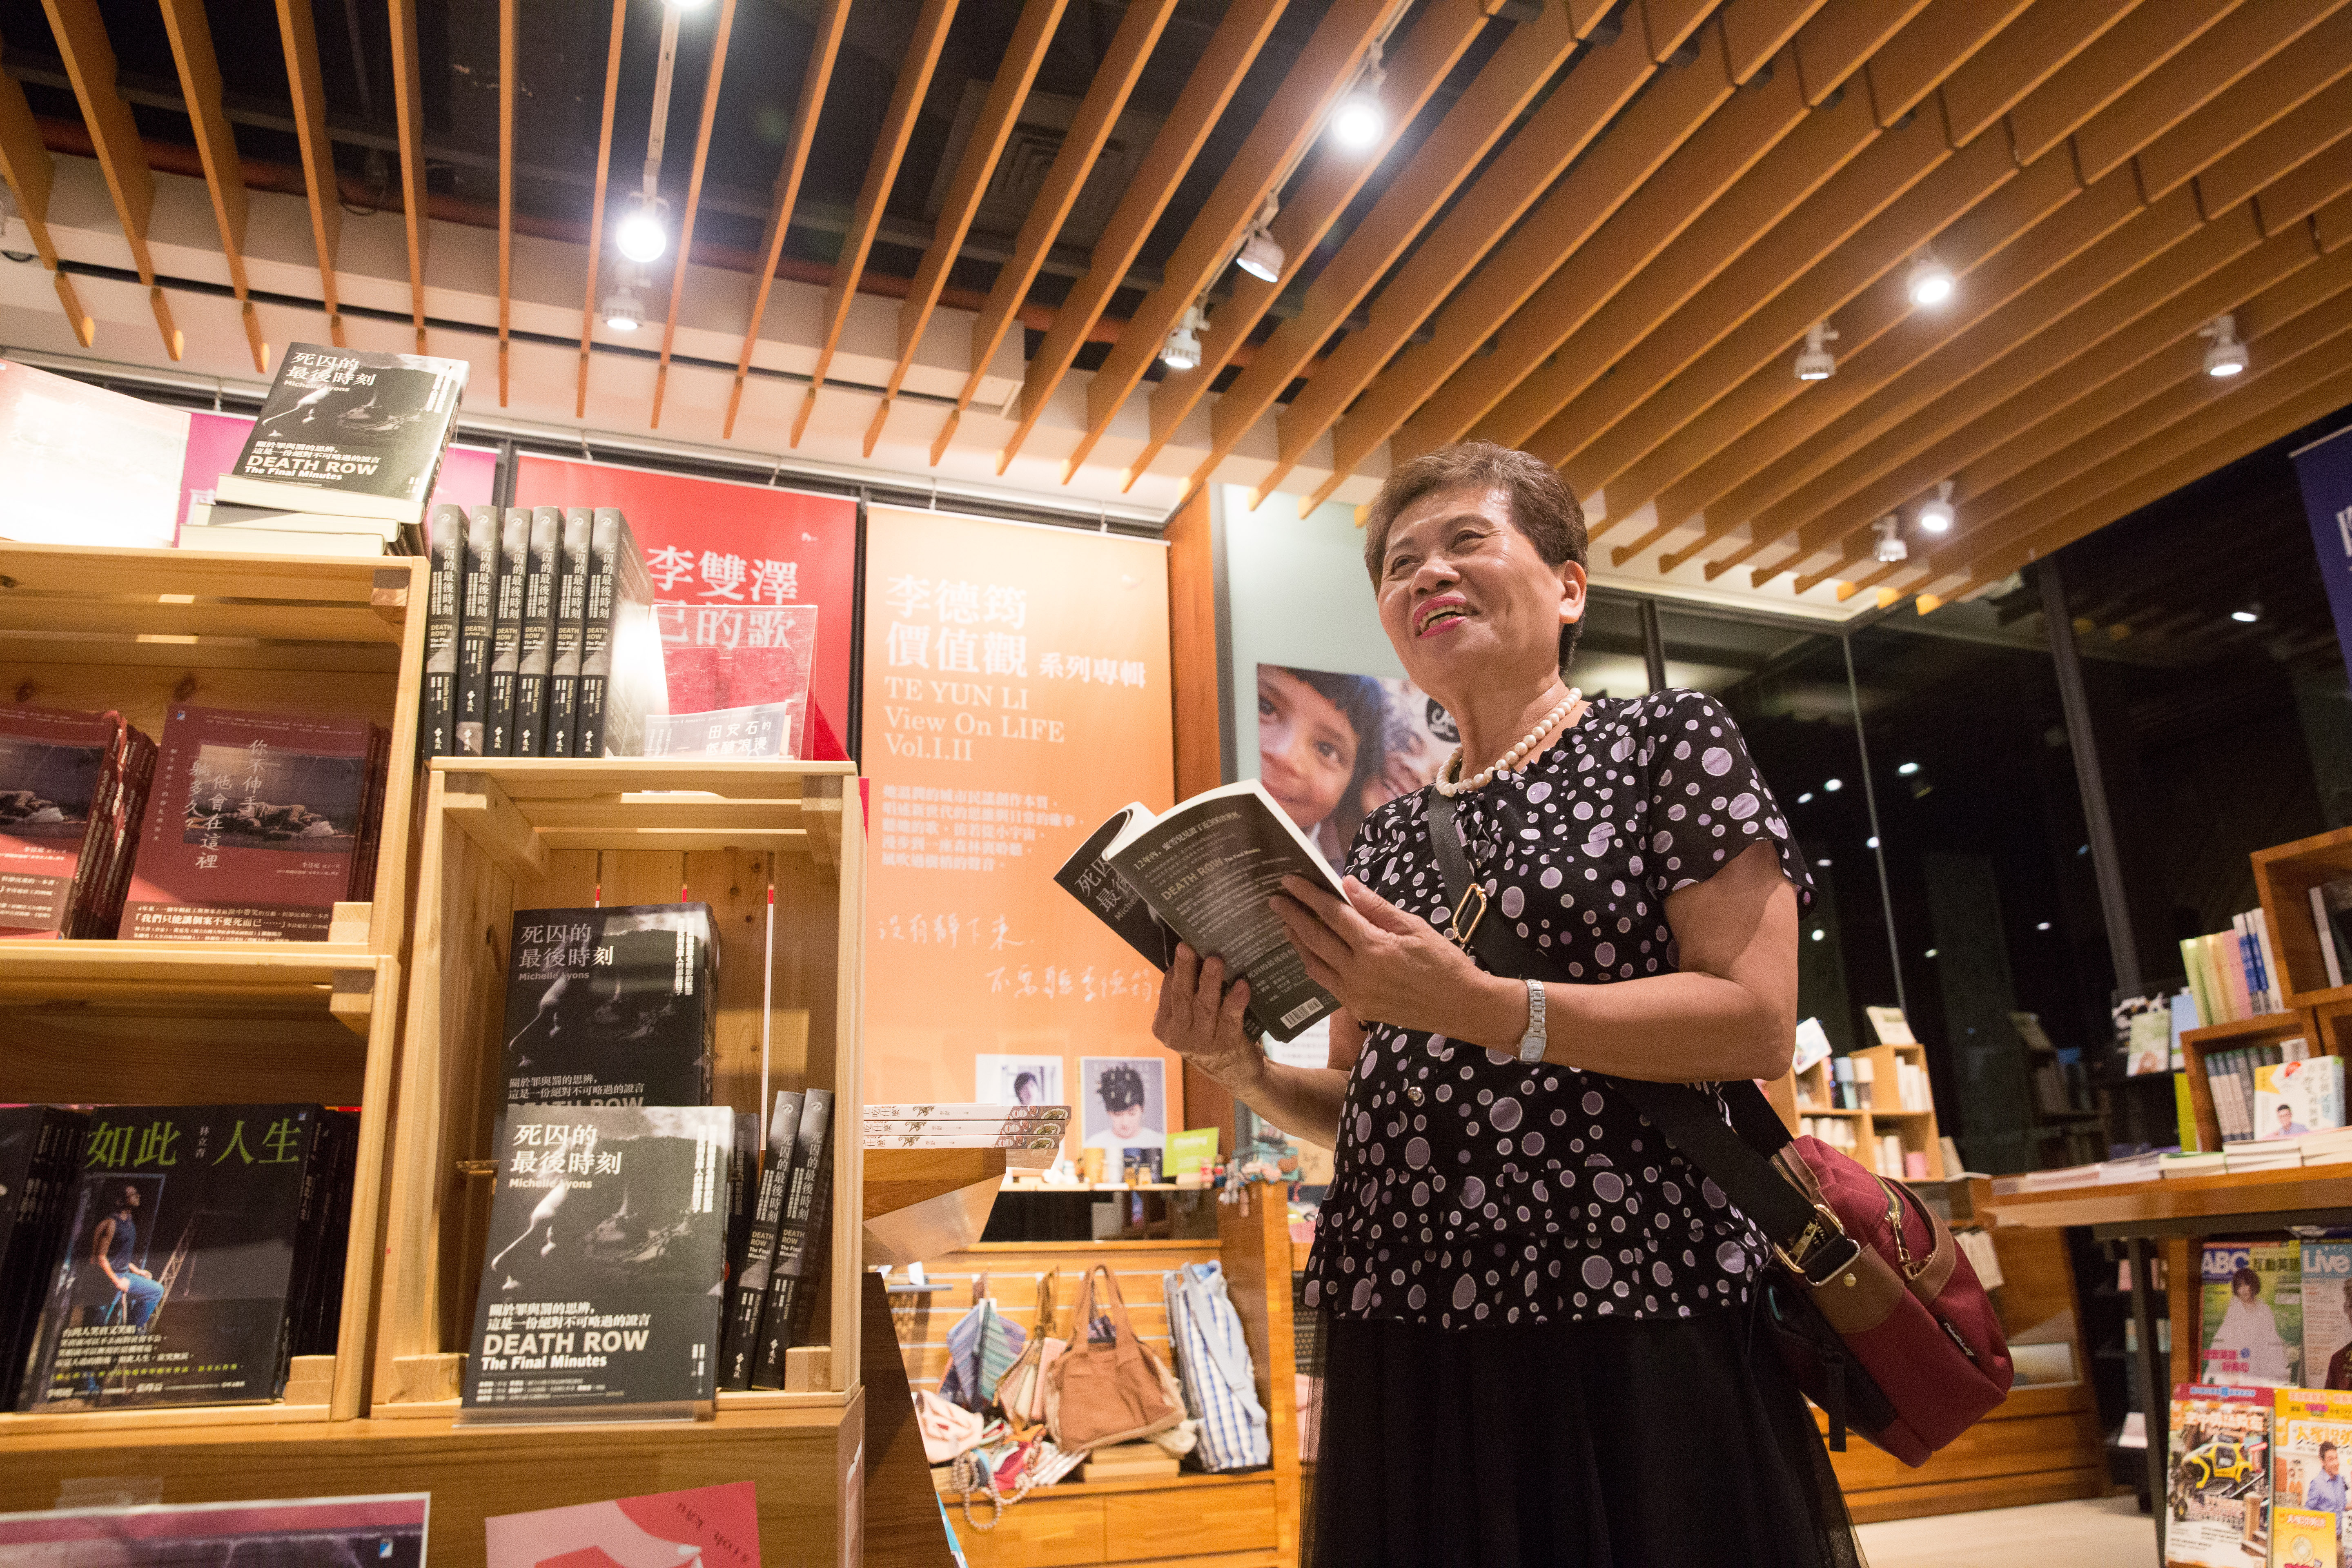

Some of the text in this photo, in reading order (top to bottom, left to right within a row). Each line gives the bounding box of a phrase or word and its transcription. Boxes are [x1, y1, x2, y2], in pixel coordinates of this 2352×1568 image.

[290, 352, 360, 372] 死囚的
[286, 366, 377, 387] 最後時刻
[245, 466, 343, 481] The Final Minutes
[247, 455, 379, 475] DEATH ROW
[442, 538, 455, 615] 死囚的最後時刻
[476, 541, 492, 617] 死囚的最後時刻
[508, 543, 526, 619] 死囚的最後時刻
[537, 541, 554, 618] 死囚的最後時刻
[570, 543, 587, 619] 死囚的最後時刻
[599, 543, 615, 619] 死囚的最後時刻
[647, 545, 798, 605] 李雙澤
[884, 574, 1027, 630] 李德筠
[884, 620, 1146, 689] 價值觀 系列專輯
[884, 676, 1029, 710] TE YUN LI
[884, 706, 1065, 743] View On LIFE
[195, 774, 232, 869] 他會在這裡
[1162, 873, 1198, 900] DEATH
[1196, 857, 1224, 876] ROW
[519, 923, 592, 945] 死囚的
[519, 945, 614, 968] 最後時刻
[519, 972, 558, 980] Michelle
[508, 1082, 645, 1099] 這是一份絕對不可略過的證言
[84, 1122, 181, 1169] 如此
[212, 1117, 302, 1167] 人生
[512, 1123, 598, 1147] 死囚的
[510, 1150, 623, 1176] 最後時刻
[766, 1133, 793, 1224] 死囚的最後時刻
[797, 1132, 822, 1221] 死囚的最後時刻
[751, 1238, 767, 1247] ROW
[752, 1231, 774, 1241] DEATH
[782, 1236, 798, 1245] ROW
[783, 1229, 805, 1238] DEATH
[2202, 1250, 2250, 1274] ABC
[2303, 1249, 2350, 1274] Live
[486, 1314, 651, 1331] 這是一份絕對不可略過的證言
[482, 1329, 650, 1356] DEATH ROW
[481, 1354, 607, 1371] The Final Minutes
